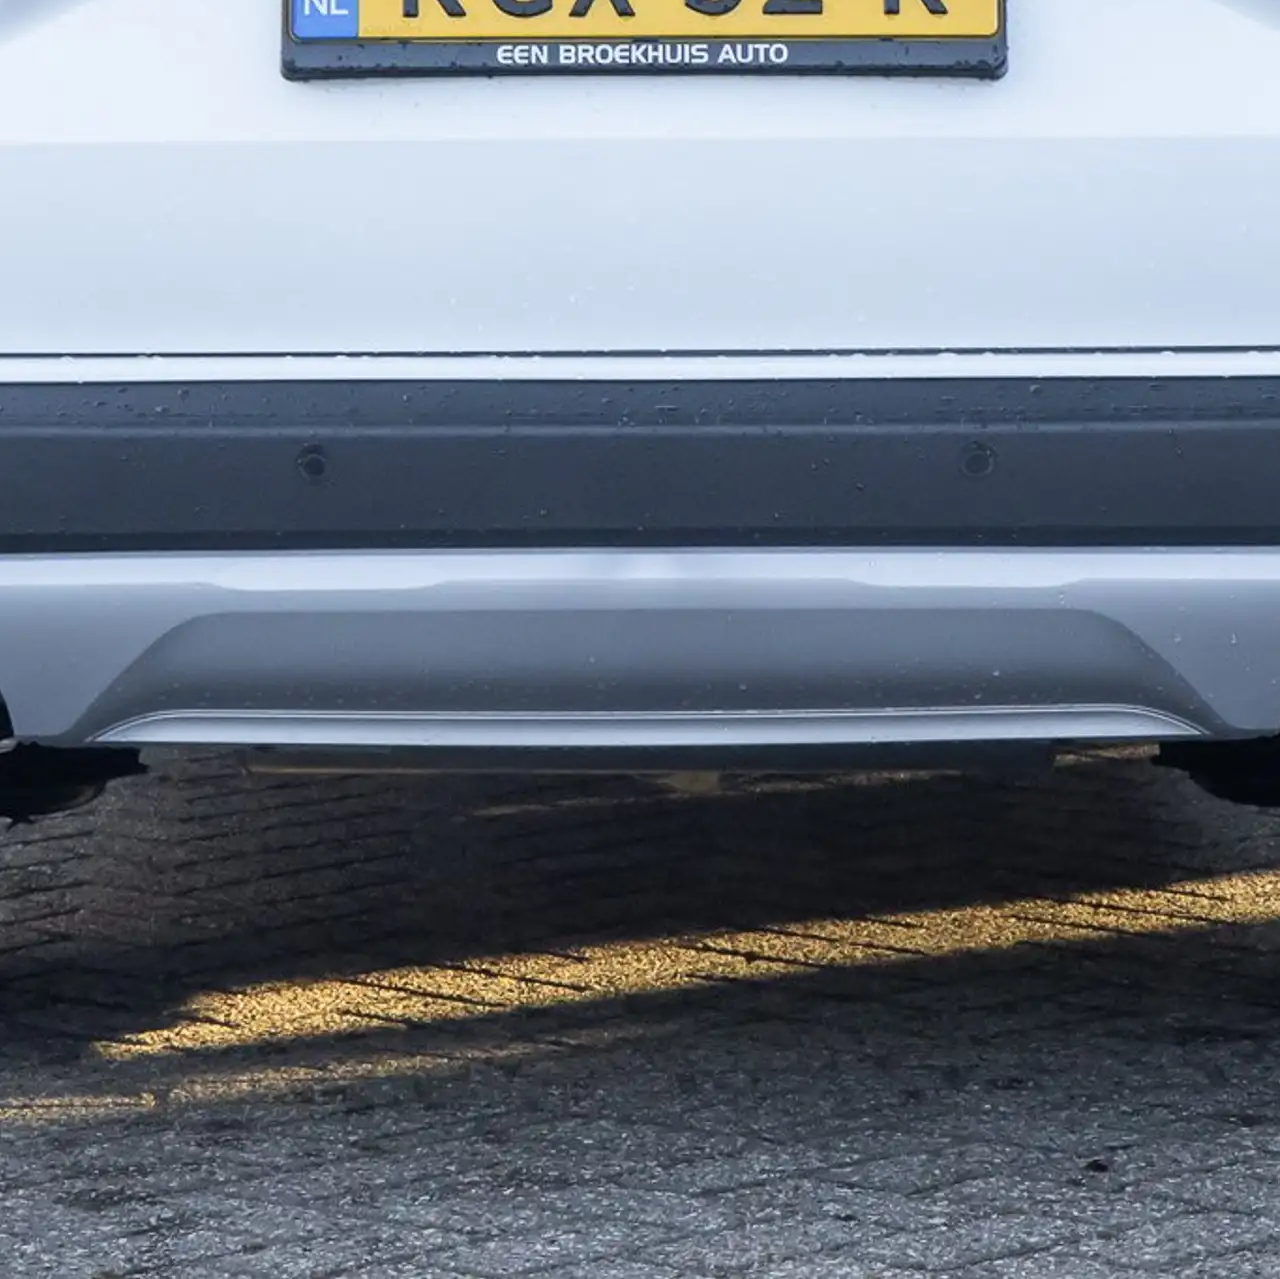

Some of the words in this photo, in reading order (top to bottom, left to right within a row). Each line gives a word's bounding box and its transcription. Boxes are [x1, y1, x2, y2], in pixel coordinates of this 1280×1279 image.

[496, 44, 550, 65] EEN
[558, 43, 710, 65] BROEKHUIS
[716, 43, 790, 65] AUTO
